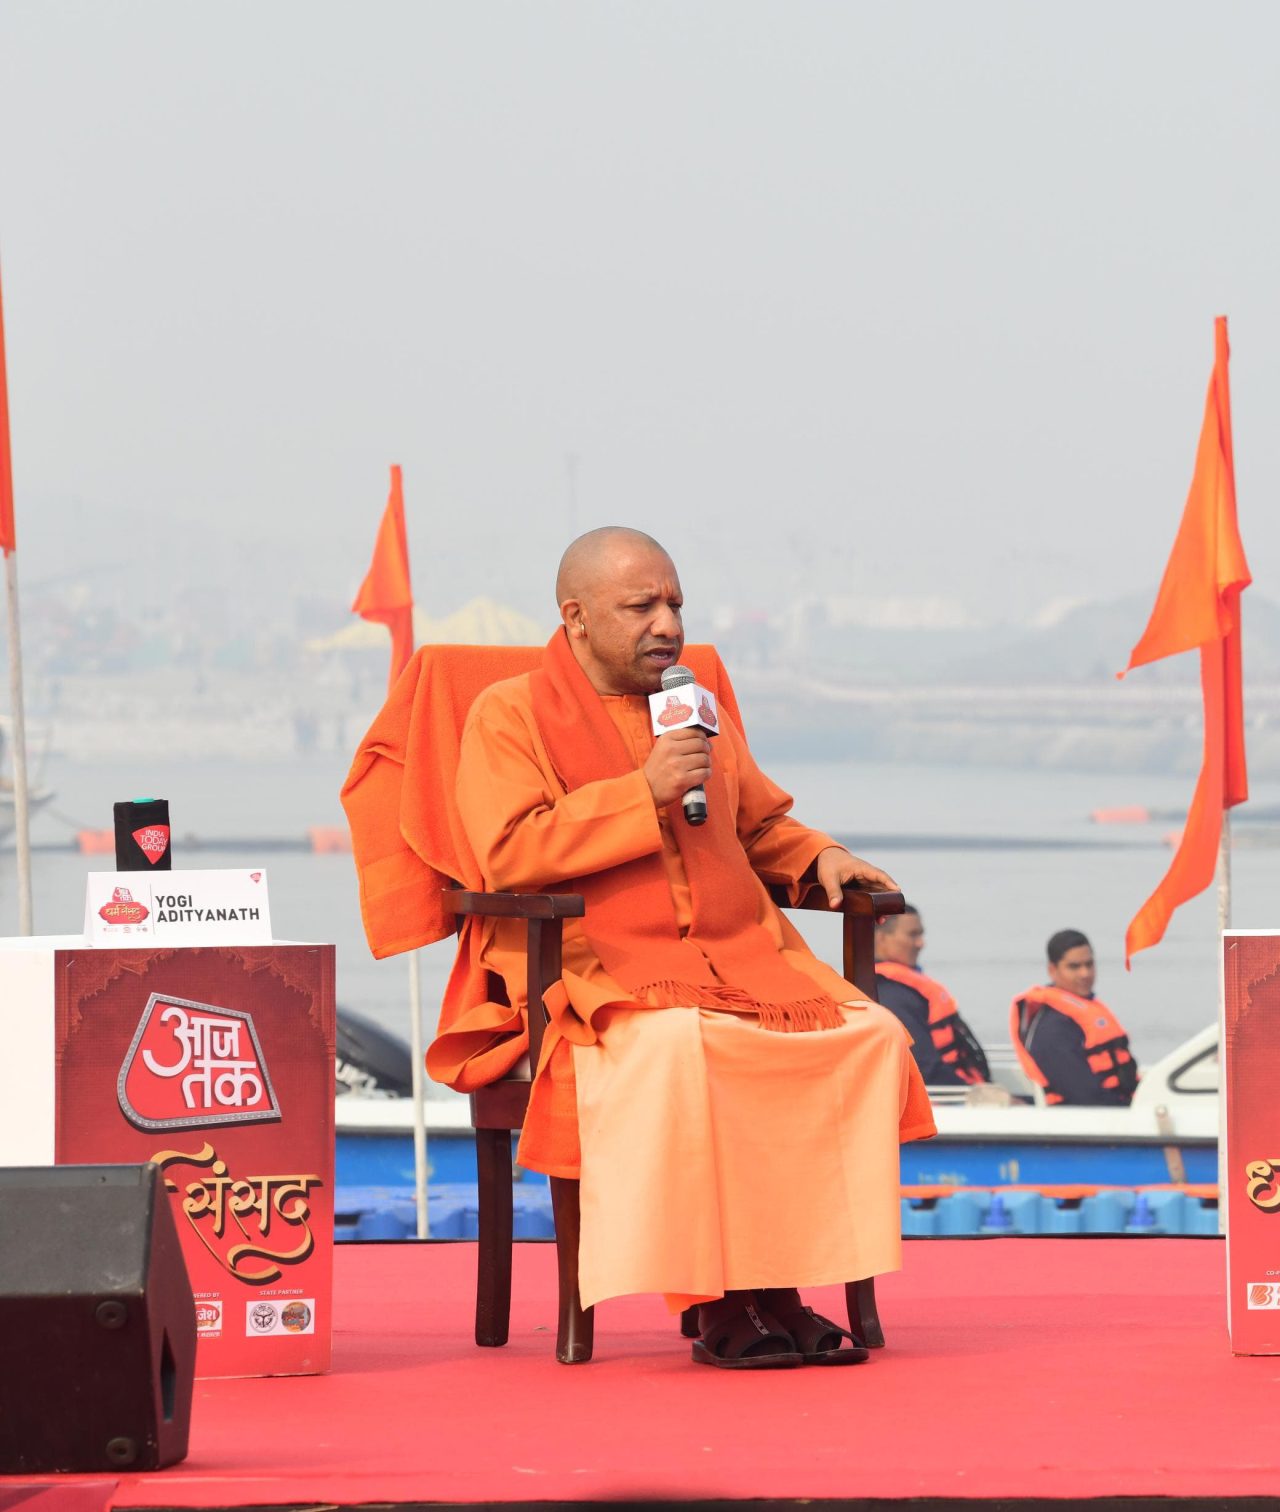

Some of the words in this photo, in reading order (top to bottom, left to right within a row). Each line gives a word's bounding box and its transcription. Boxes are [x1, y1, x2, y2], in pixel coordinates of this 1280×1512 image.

[140, 835, 168, 845] TODAY
[146, 830, 165, 838] INDIA
[141, 843, 166, 852] GROUP
[155, 895, 193, 908] YOGI
[157, 908, 260, 923] ADITYANATH
[142, 1006, 241, 1077] आज
[181, 1058, 263, 1109] तक
[183, 1162, 323, 1281] संसद
[196, 1308, 217, 1320] जेश
